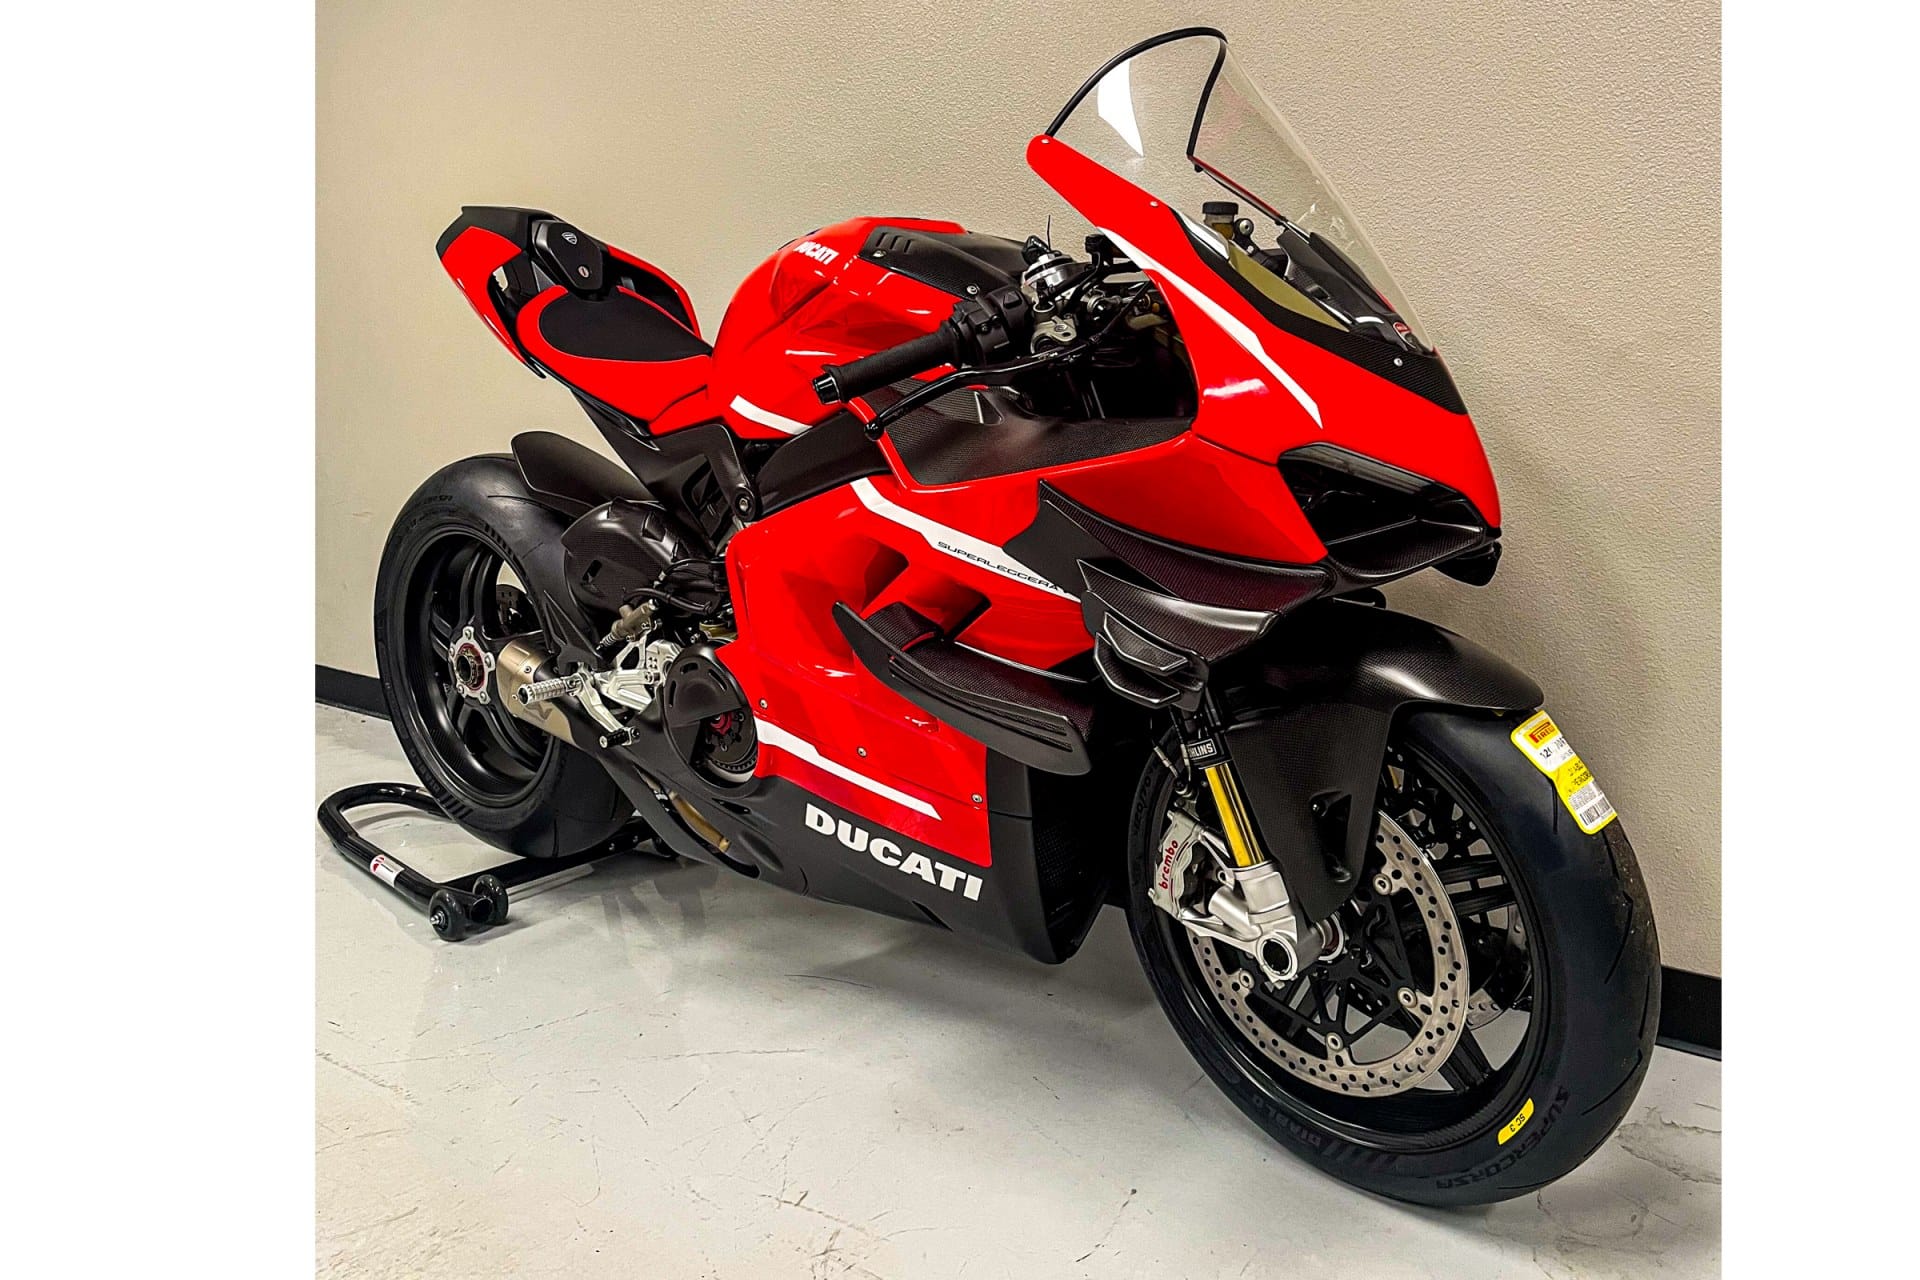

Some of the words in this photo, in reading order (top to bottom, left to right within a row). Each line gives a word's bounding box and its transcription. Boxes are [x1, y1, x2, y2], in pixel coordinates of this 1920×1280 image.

[937, 541, 1059, 591] SUPERLEGGERA
[1187, 743, 1213, 758] HLINS
[804, 802, 983, 902] DUCATI
[1158, 840, 1178, 889] brembo
[1436, 1085, 1569, 1189] SUPERCORSA
